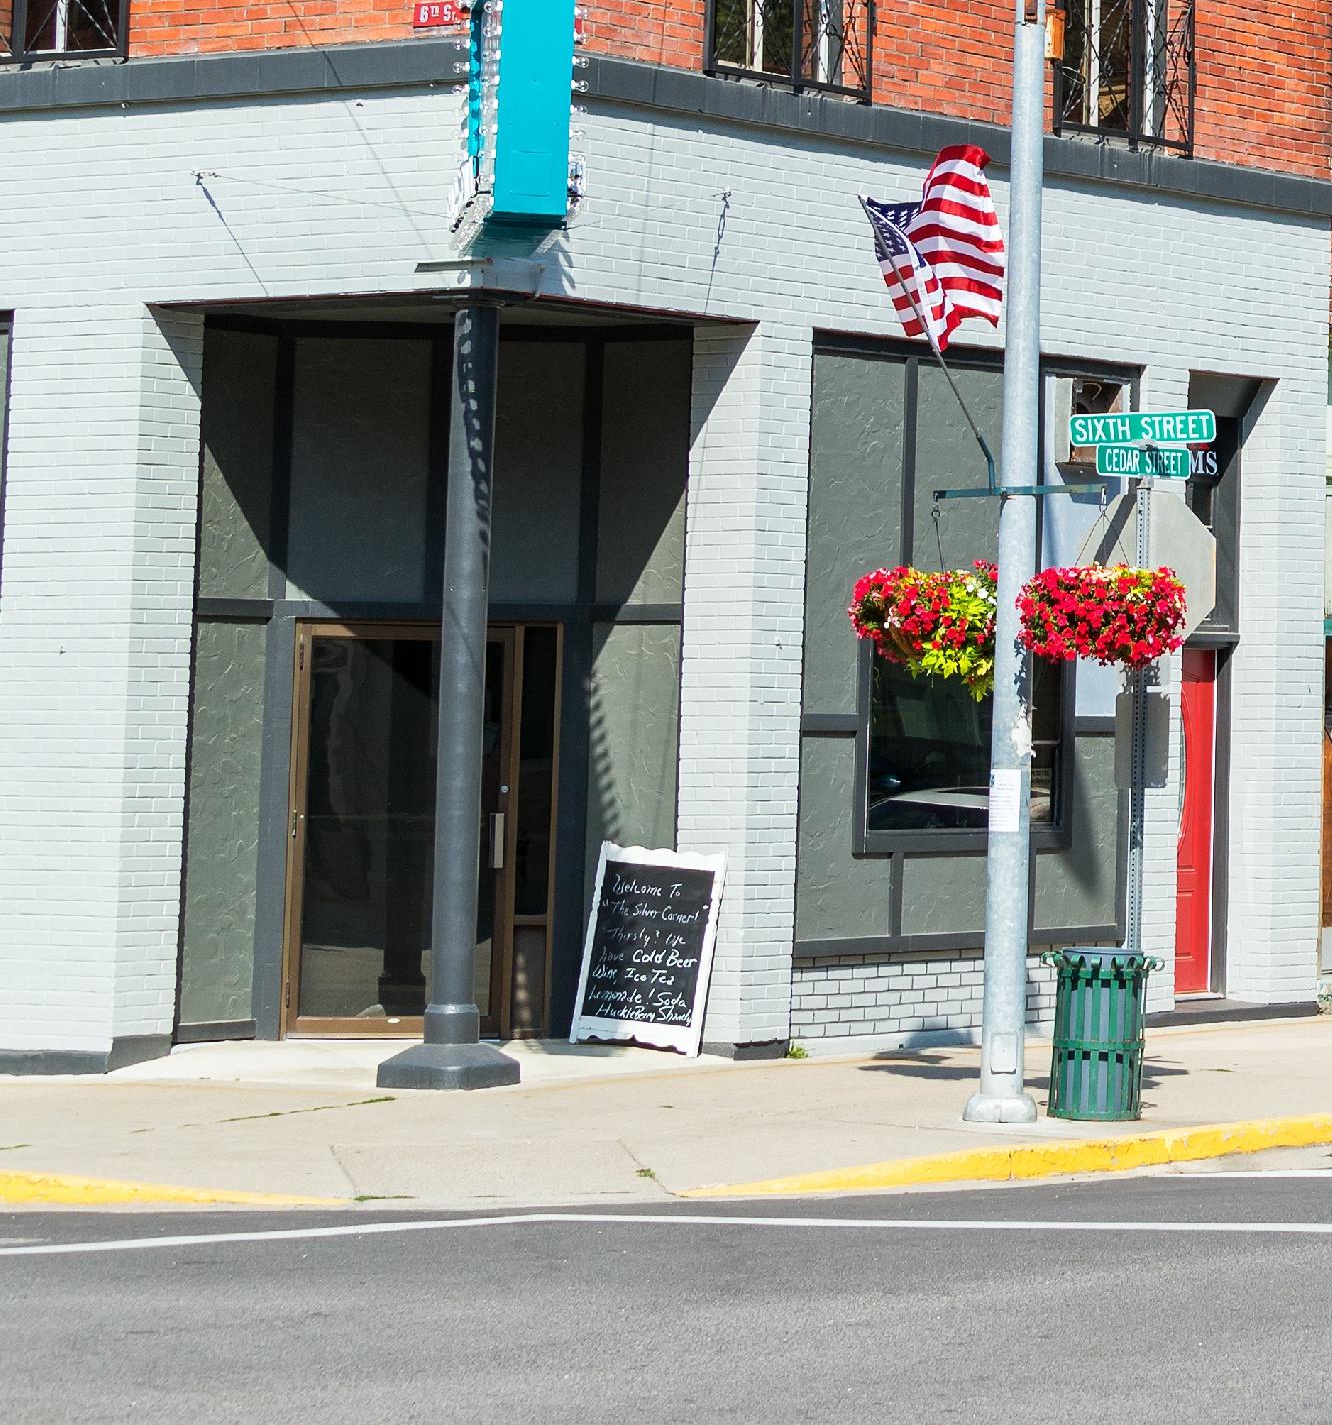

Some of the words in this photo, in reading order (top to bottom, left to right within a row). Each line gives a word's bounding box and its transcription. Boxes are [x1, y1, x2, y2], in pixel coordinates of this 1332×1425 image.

[1074, 417, 1132, 442] SIXTH
[1140, 415, 1210, 440] STREET
[1105, 447, 1140, 473] CEDAR
[1145, 450, 1183, 475] STREET
[612, 873, 661, 897] Welcome
[669, 883, 683, 898] To
[632, 902, 660, 919] Silver
[599, 945, 624, 962] have
[632, 948, 666, 963] Cold
[666, 949, 698, 968] Beer
[624, 967, 647, 982] Ice
[651, 968, 675, 986] Tea
[652, 991, 687, 1007] Soda
